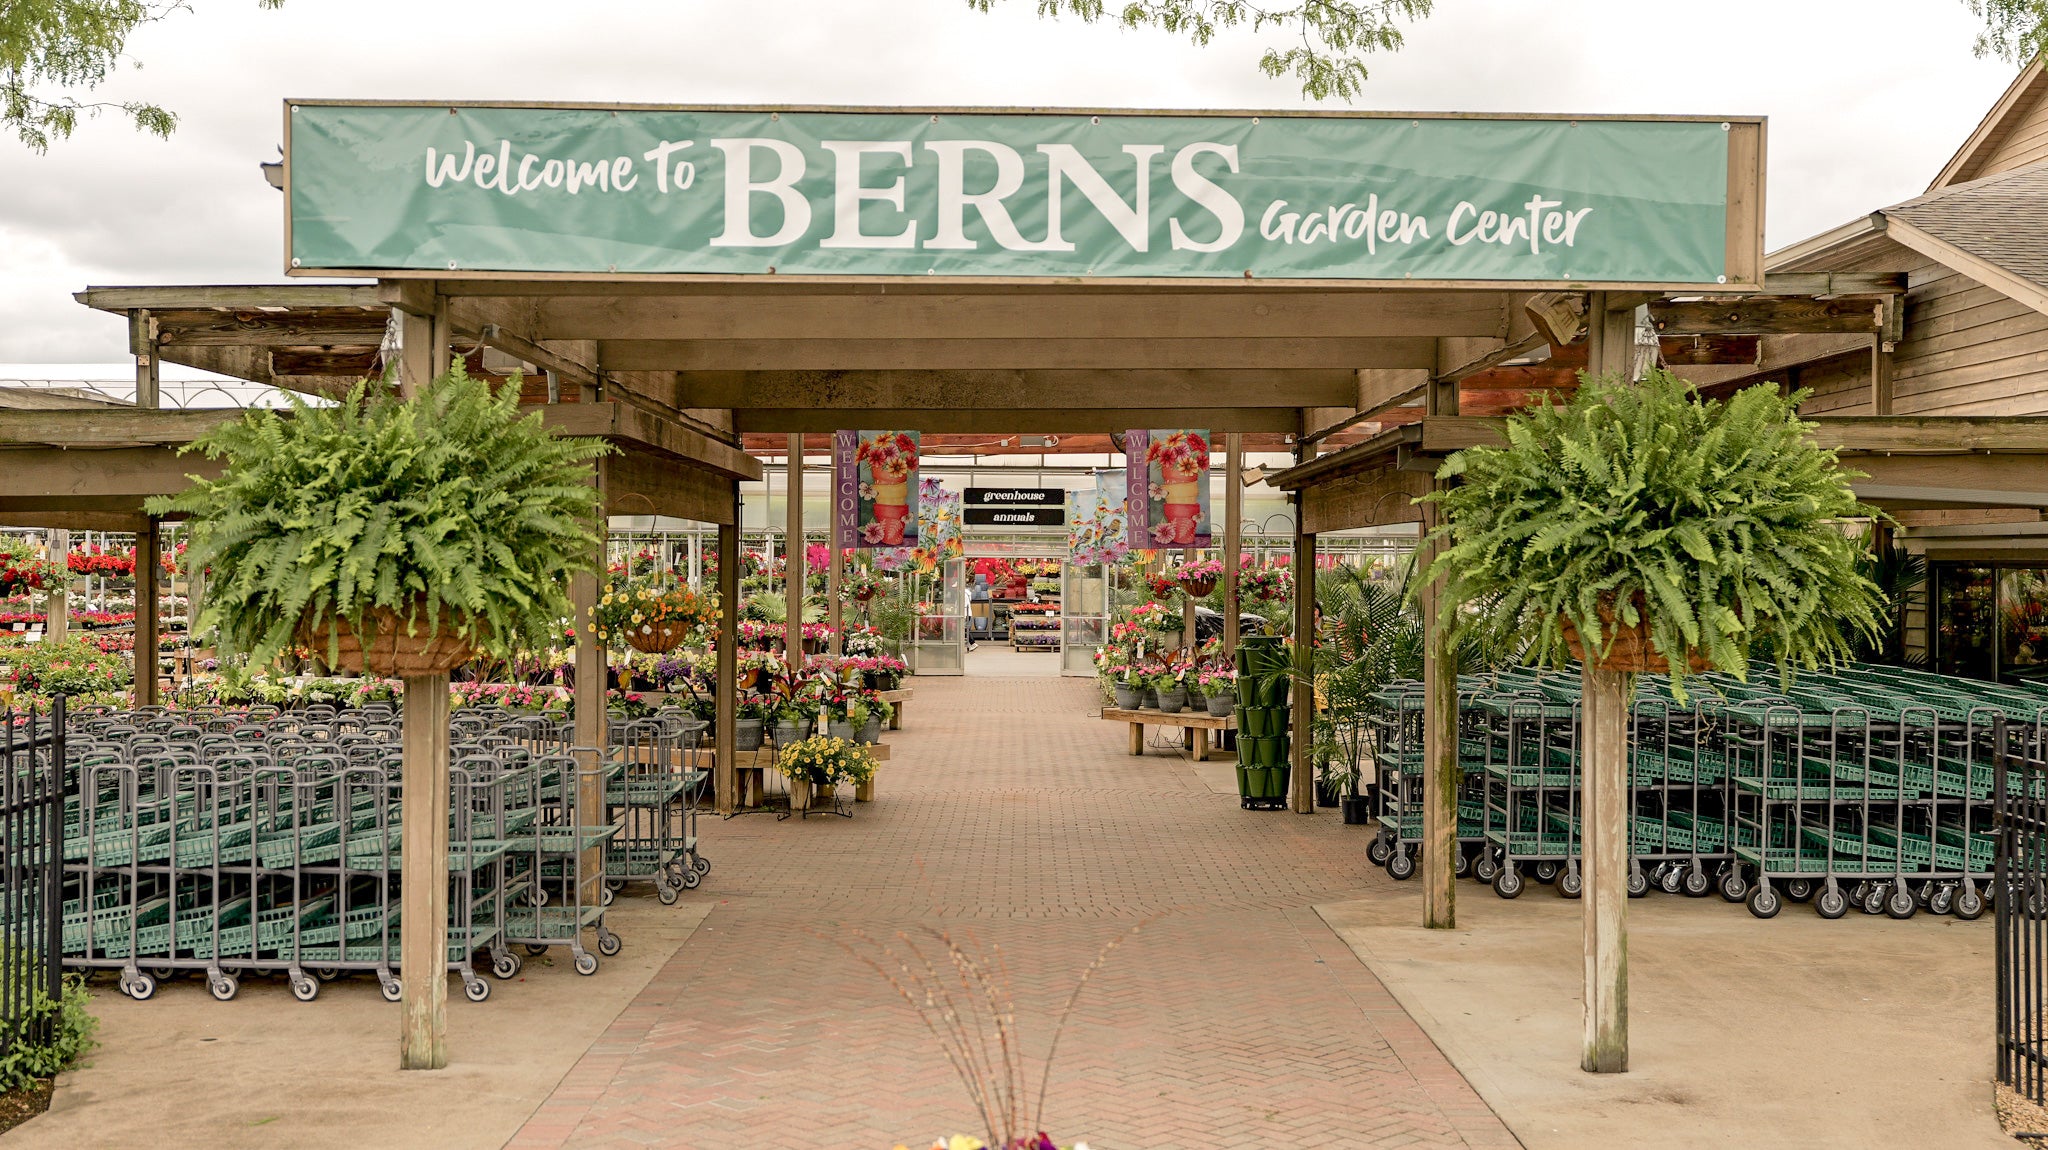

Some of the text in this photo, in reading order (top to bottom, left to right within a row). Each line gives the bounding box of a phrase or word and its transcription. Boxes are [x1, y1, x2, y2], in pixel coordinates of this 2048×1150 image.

[425, 140, 639, 196] Welcome
[709, 137, 1245, 254] BERNS
[1259, 193, 1431, 256] Garden
[1447, 194, 1594, 255] Center
[839, 434, 855, 544] WELCOME
[983, 490, 1046, 503] greenhouse
[993, 511, 1035, 523] annuals
[1130, 434, 1146, 544] WELCOME
